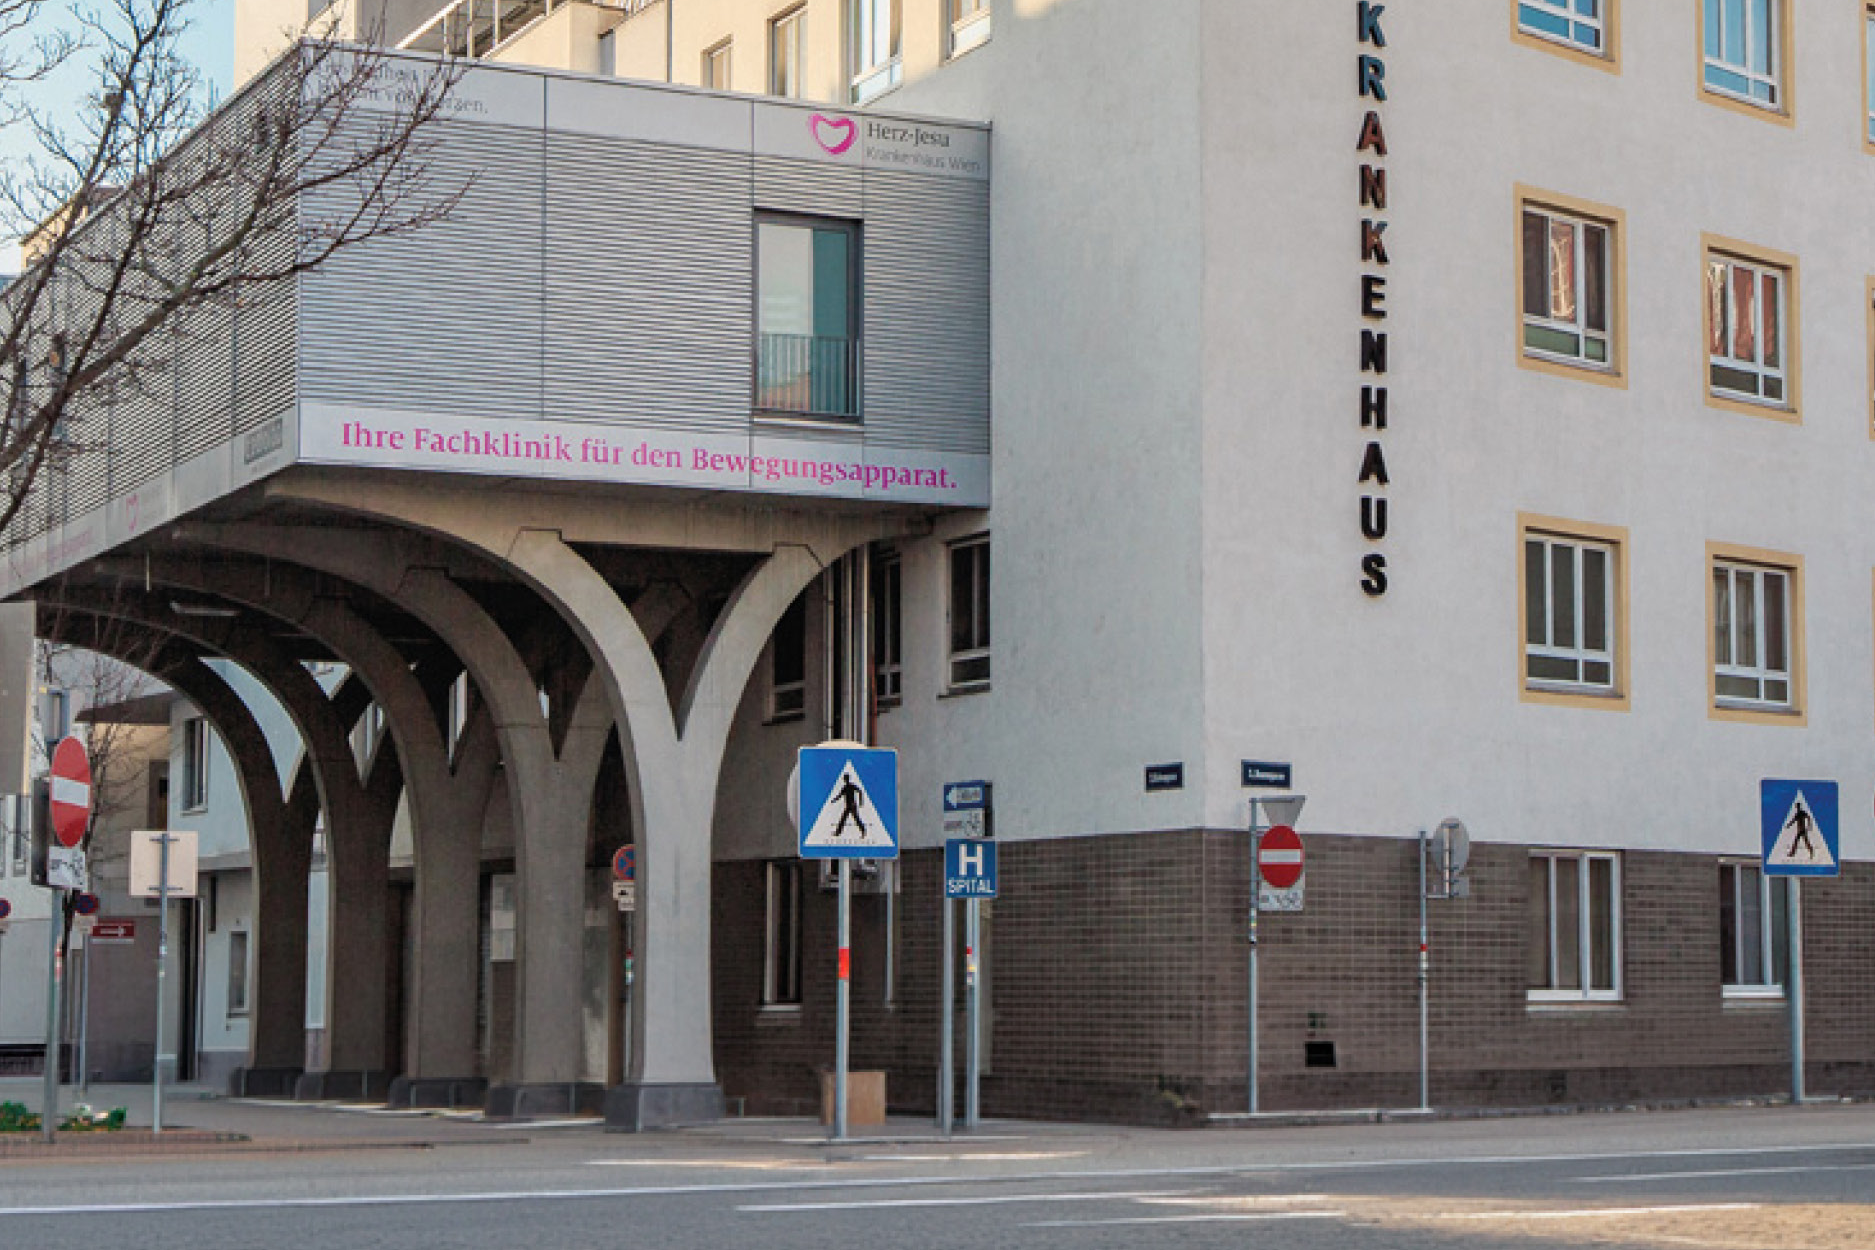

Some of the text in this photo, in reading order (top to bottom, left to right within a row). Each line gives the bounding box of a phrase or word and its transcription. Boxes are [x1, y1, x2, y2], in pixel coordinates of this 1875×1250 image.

[866, 121, 950, 148] Herz-Jesu
[1355, 0, 1390, 597] KRANKENHAUS
[342, 421, 957, 490] Ihre Fachklinik für den Bewegungsapparat.
[959, 843, 983, 876] H
[947, 878, 994, 894] SPITAL
